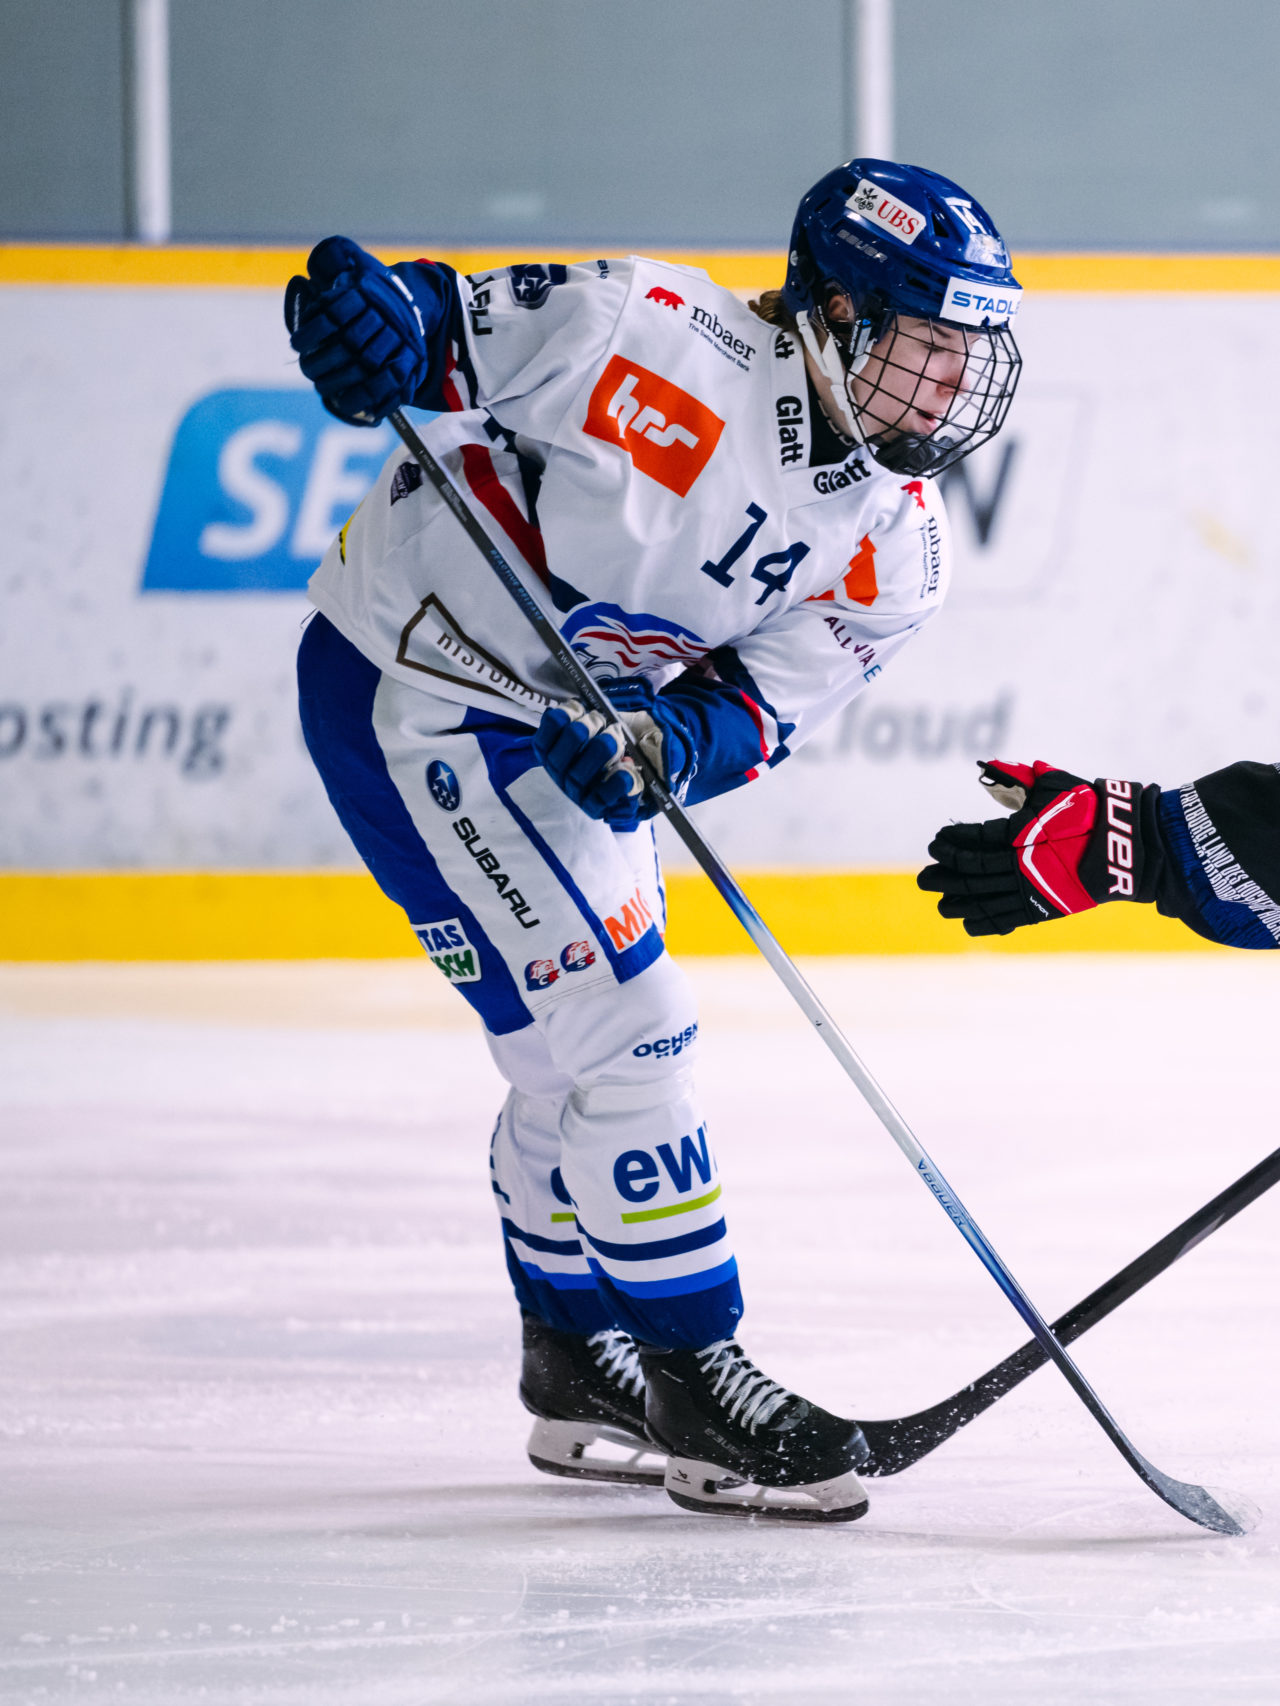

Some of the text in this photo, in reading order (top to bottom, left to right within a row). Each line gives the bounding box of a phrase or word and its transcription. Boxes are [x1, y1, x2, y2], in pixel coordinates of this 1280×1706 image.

[837, 228, 888, 263] BAUER
[877, 200, 920, 235] UBS
[690, 305, 757, 361] mbaer
[606, 373, 700, 450] hrs
[776, 395, 804, 467] Glatt
[813, 457, 871, 495] Glatt
[700, 501, 811, 606] 14
[927, 515, 942, 597] mbaer
[800, 689, 1014, 763] loud
[452, 816, 541, 930] SUBARU
[604, 887, 653, 951] MI
[430, 949, 477, 979] SCH
[613, 1119, 719, 1203] ew
